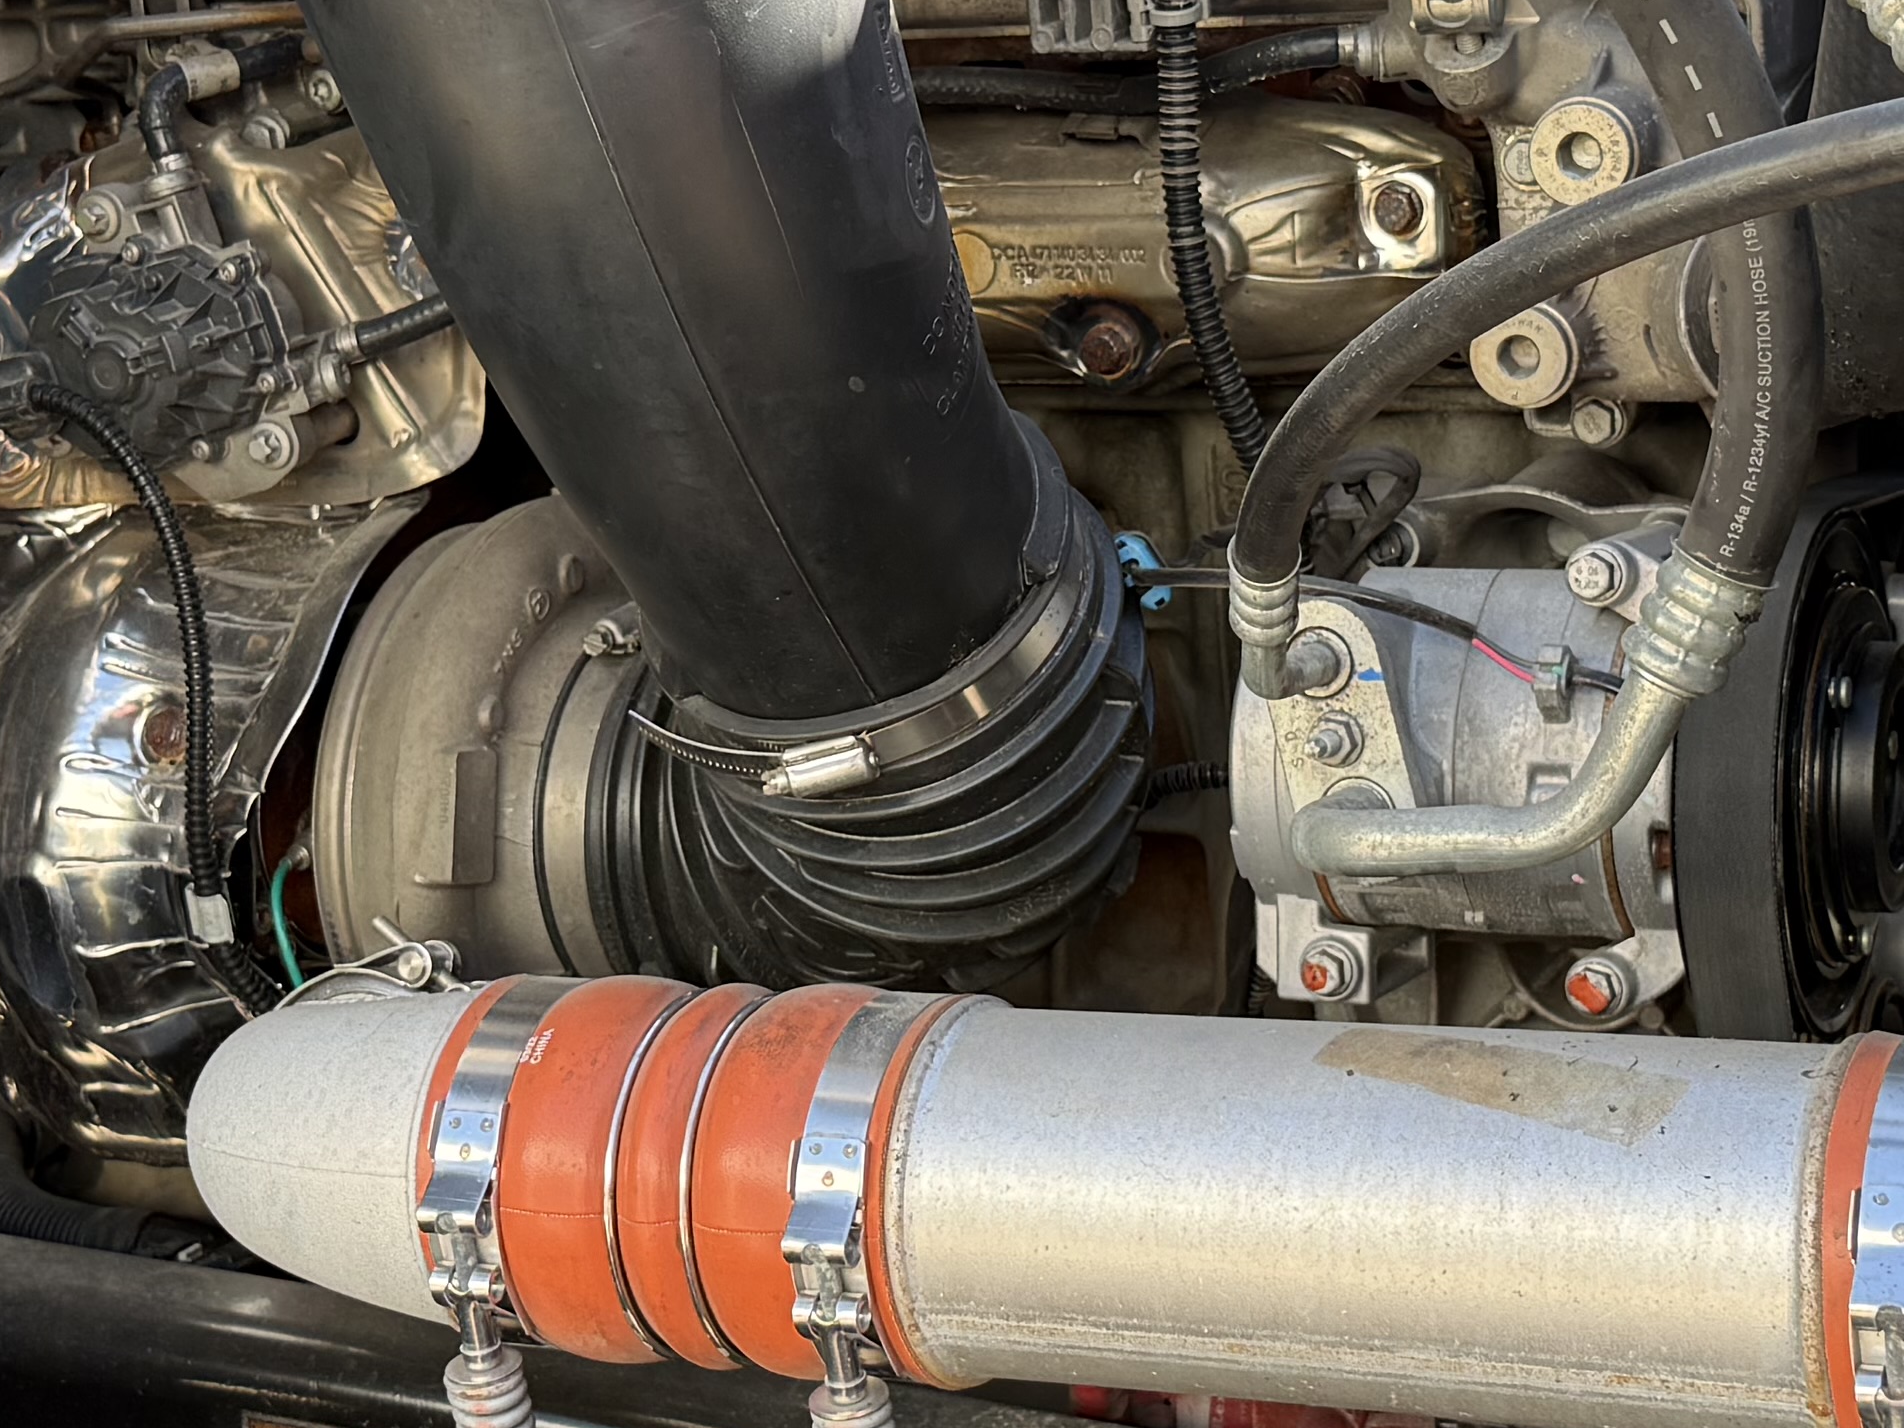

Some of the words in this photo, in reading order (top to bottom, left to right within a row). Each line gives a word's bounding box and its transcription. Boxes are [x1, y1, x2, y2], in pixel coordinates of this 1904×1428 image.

[1751, 256, 1769, 305] HOSE
[1755, 309, 1773, 388] SUCTION
[1755, 388, 1772, 422] A/C
[1743, 419, 1771, 493] R-1234yf
[1718, 505, 1752, 559] R-134a
[530, 1028, 555, 1064] CHINA
